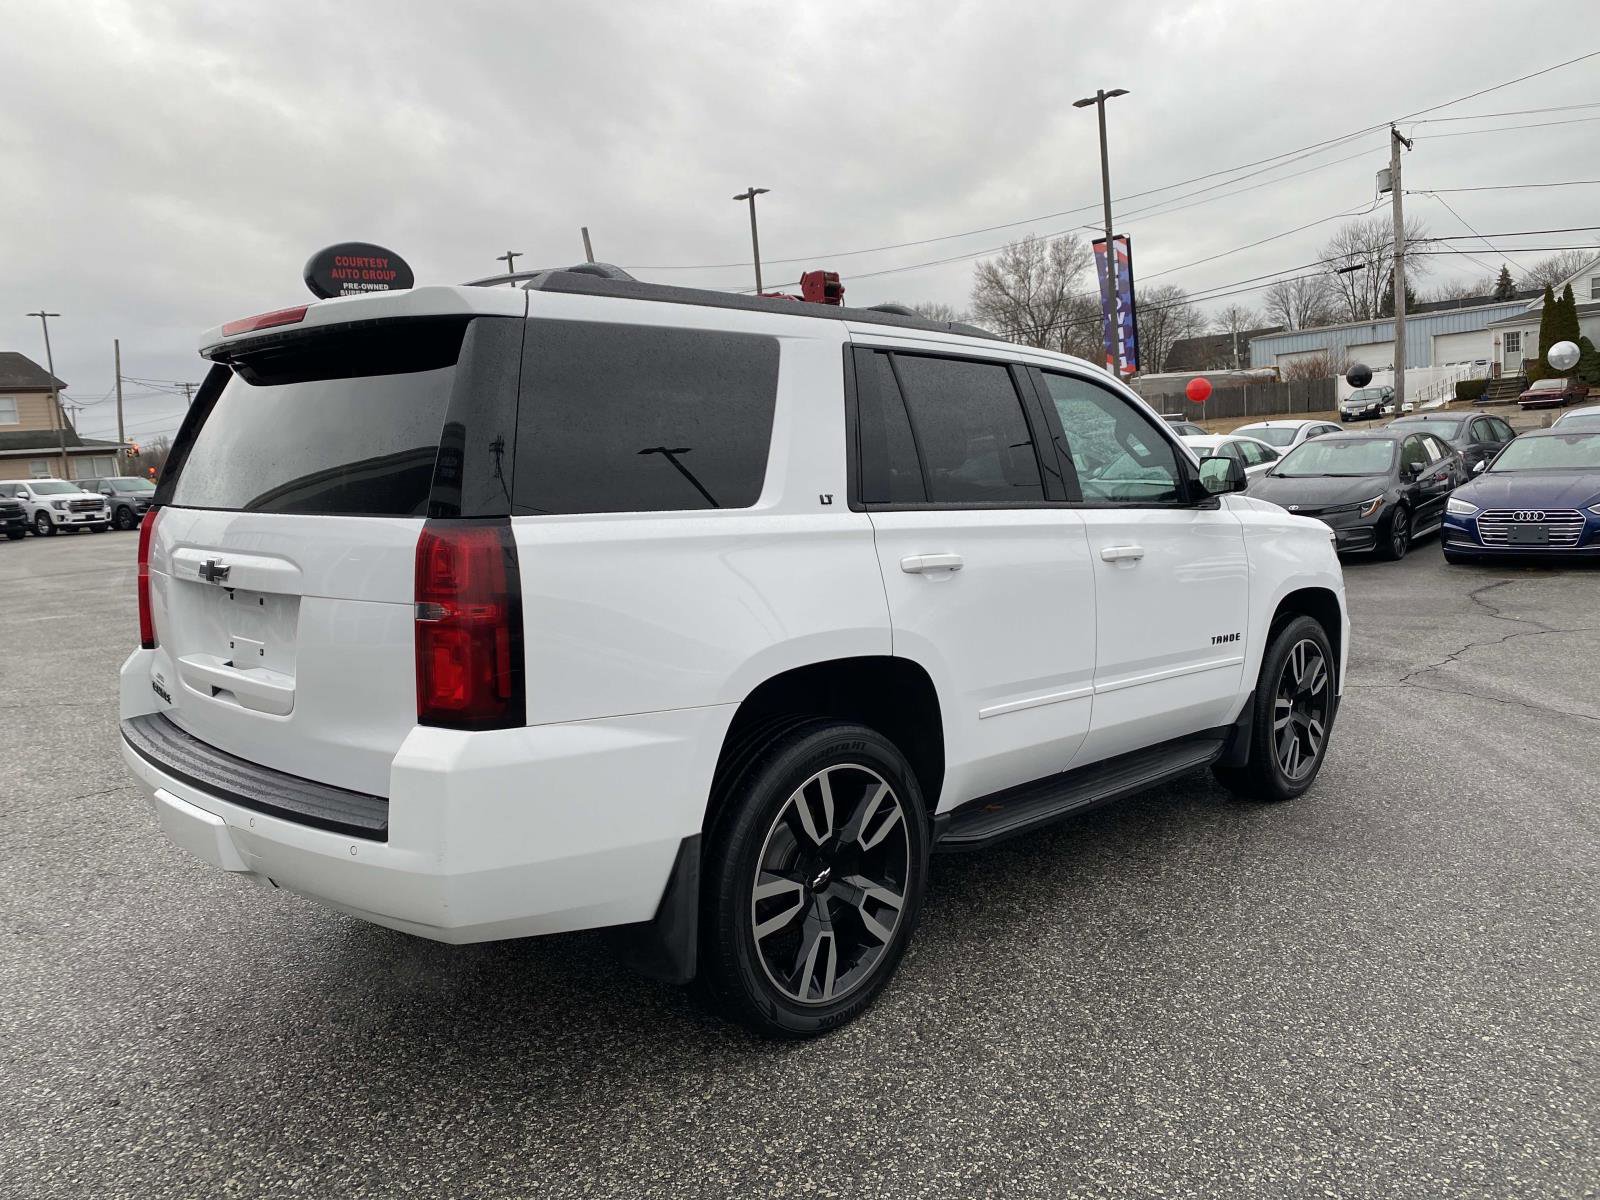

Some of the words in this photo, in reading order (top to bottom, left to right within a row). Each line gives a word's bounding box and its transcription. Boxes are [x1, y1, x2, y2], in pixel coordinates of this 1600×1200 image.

[335, 256, 388, 268] COURTESY
[331, 268, 359, 278] AUTO
[362, 269, 396, 280] GROUP
[343, 282, 388, 290] PRE-OWNED
[819, 494, 834, 505] LT
[1211, 632, 1241, 645] TAHOE
